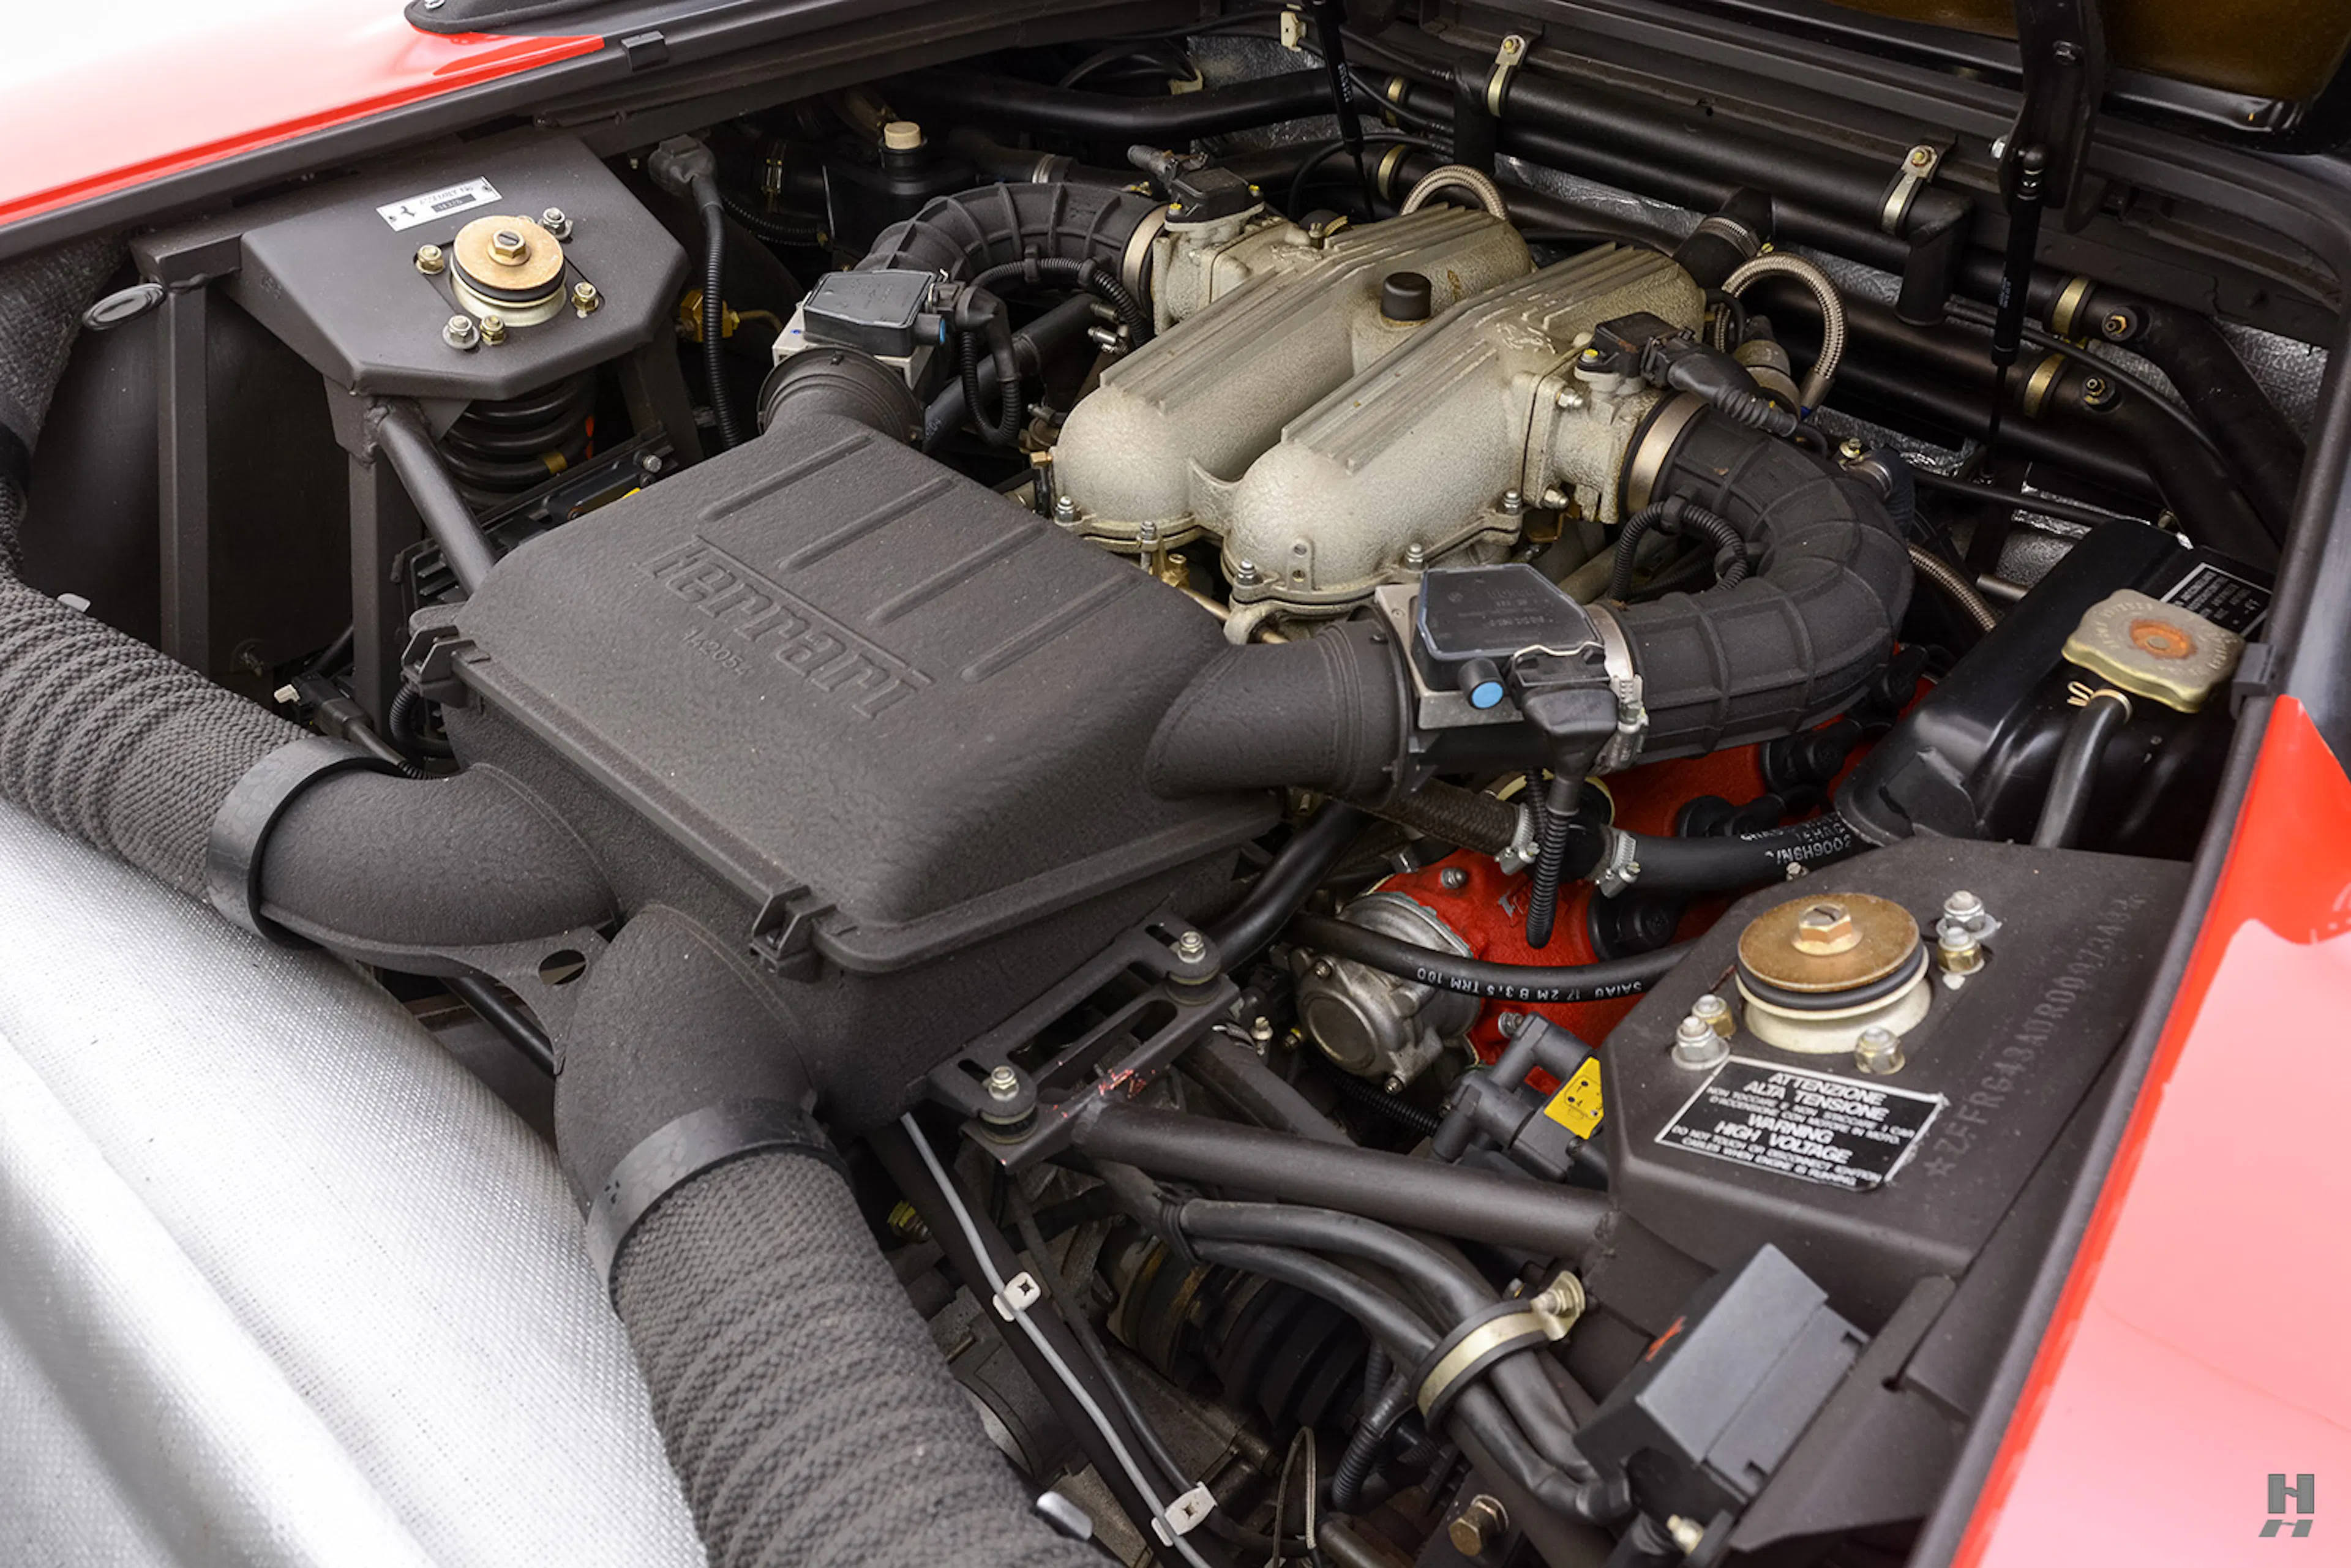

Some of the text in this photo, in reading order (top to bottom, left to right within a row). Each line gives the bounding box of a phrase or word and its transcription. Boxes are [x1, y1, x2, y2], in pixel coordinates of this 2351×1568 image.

[632, 535, 935, 720] Ferrari
[1417, 967, 1443, 985] 100
[1450, 977, 1479, 994] TRM
[1743, 1081, 1891, 1122] ALTA TENSIONE
[1768, 1072, 1888, 1106] ATTENZIONE
[1714, 1120, 1854, 1164] HIGH VOLTAGE
[1748, 1113, 1834, 1144] WARNING
